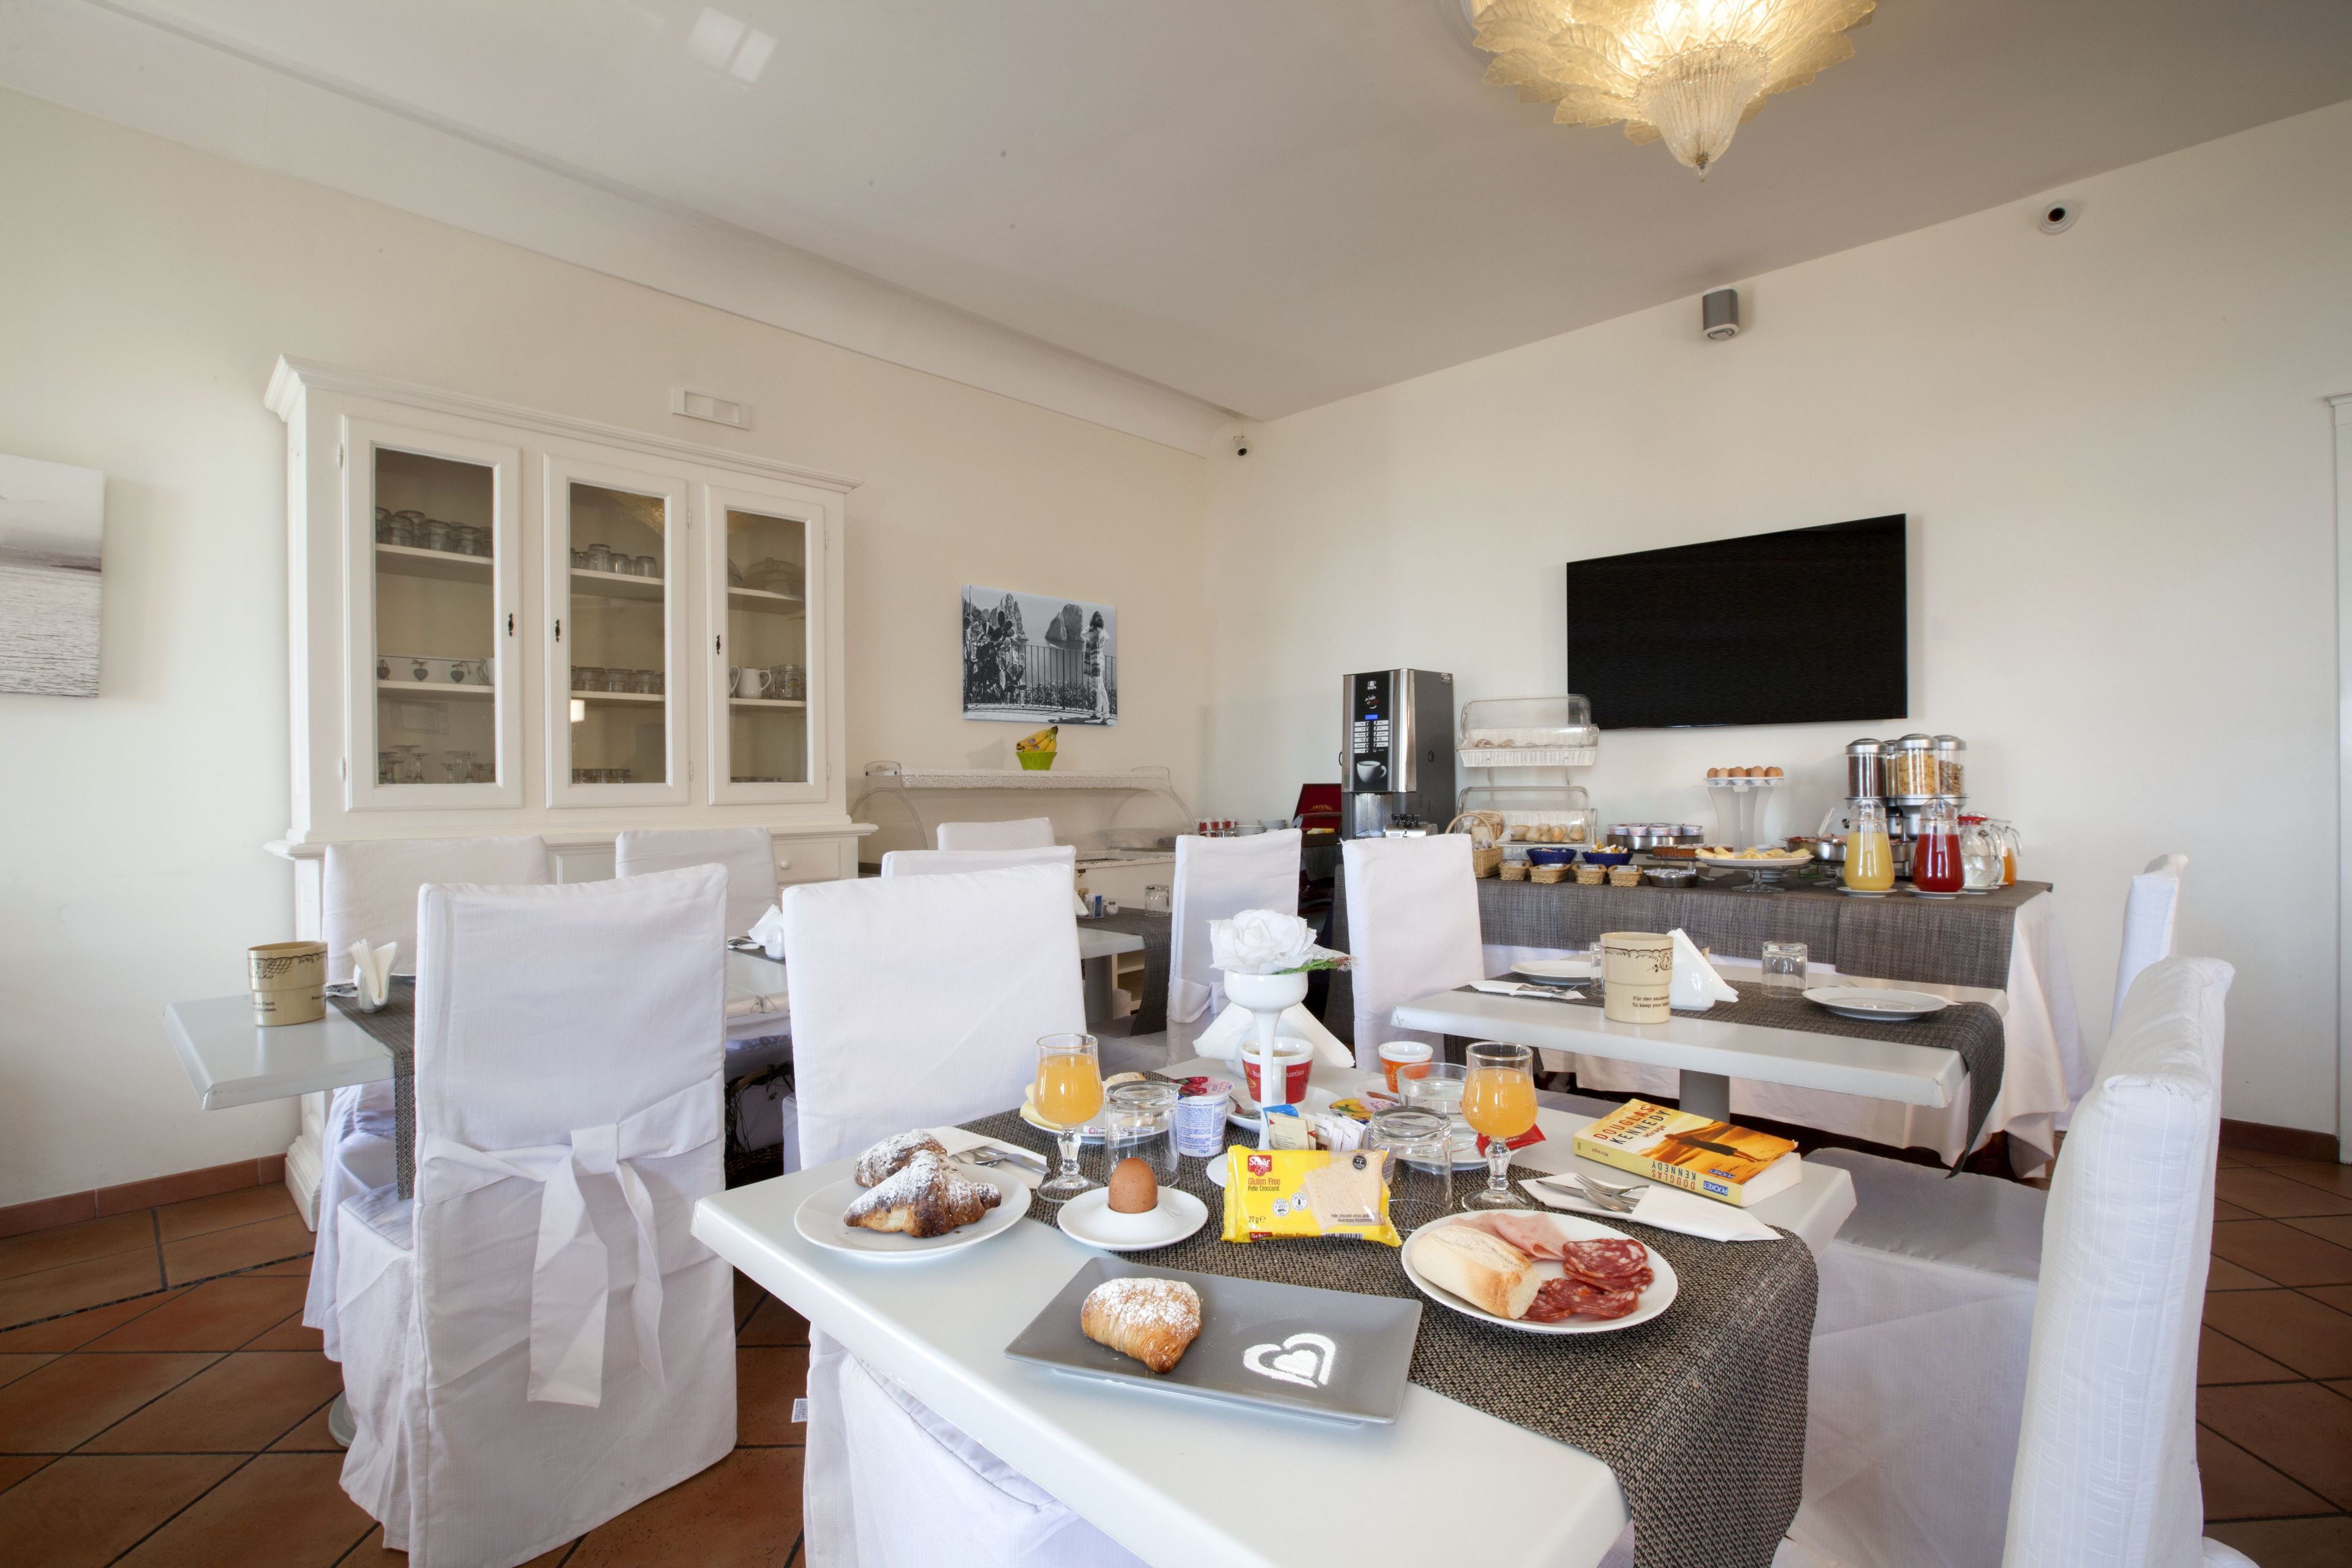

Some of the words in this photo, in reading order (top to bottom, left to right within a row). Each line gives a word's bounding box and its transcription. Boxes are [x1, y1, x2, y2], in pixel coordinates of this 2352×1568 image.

[1593, 1106, 1654, 1140] DOUGLAS
[1610, 1110, 1671, 1144] KENNEDY
[1643, 1125, 1667, 1138] Mirage
[1652, 1161, 1696, 1180] KENNEDY
[1652, 1169, 1695, 1189] DOUGLAS
[1709, 1169, 1735, 1178] POCKET
[1704, 1182, 1728, 1195] POCKET
